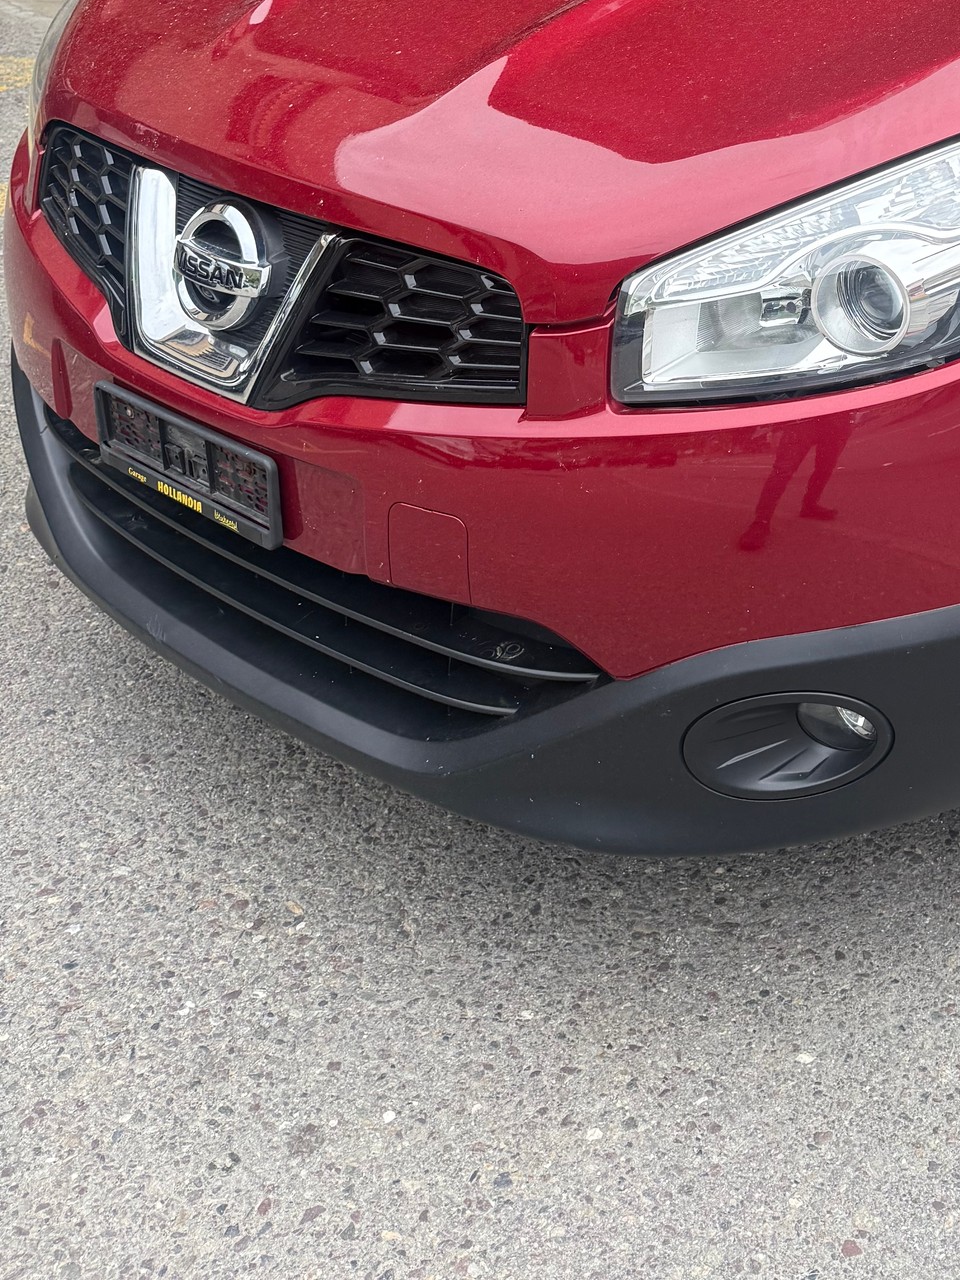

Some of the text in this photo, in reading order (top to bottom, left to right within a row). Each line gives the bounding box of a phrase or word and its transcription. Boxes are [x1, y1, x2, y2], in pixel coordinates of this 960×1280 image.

[174, 247, 244, 290] NISSAN
[128, 467, 147, 483] Garage
[157, 481, 202, 513] HOLLANDIA
